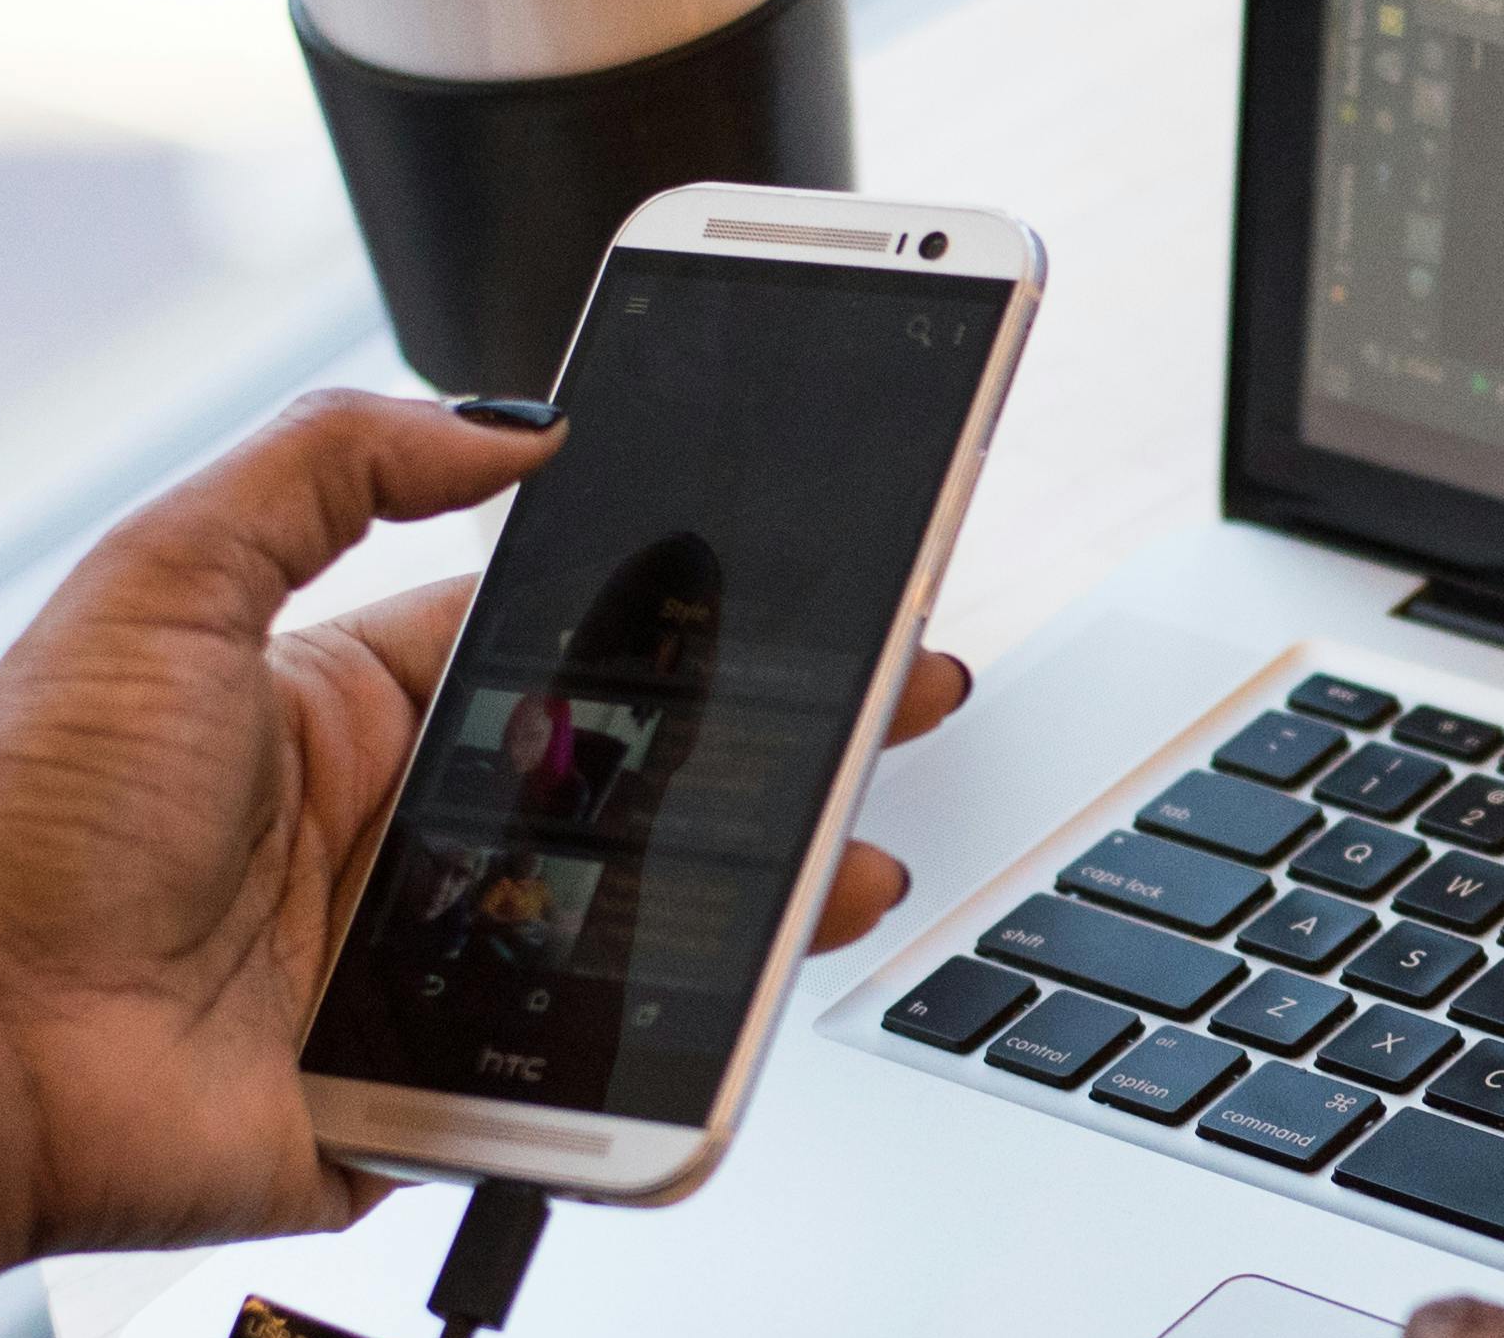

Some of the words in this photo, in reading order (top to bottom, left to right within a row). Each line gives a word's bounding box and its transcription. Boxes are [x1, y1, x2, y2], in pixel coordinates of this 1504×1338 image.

[1361, 776, 1380, 793] 1
[1159, 802, 1192, 820] tab
[1460, 809, 1486, 826] 2
[1344, 843, 1373, 864] Q
[1081, 861, 1126, 888] caps
[1126, 877, 1165, 900] lock
[1446, 875, 1483, 898] W
[1290, 915, 1319, 936] A
[1000, 924, 1046, 949] shift
[1400, 949, 1428, 968] S
[908, 998, 929, 1017] fn
[1266, 996, 1299, 1019] Z
[1005, 1032, 1073, 1065] control
[1155, 1037, 1178, 1049] alt
[1371, 1032, 1405, 1054] X
[1110, 1069, 1172, 1100] option
[1220, 1104, 1317, 1149] command
